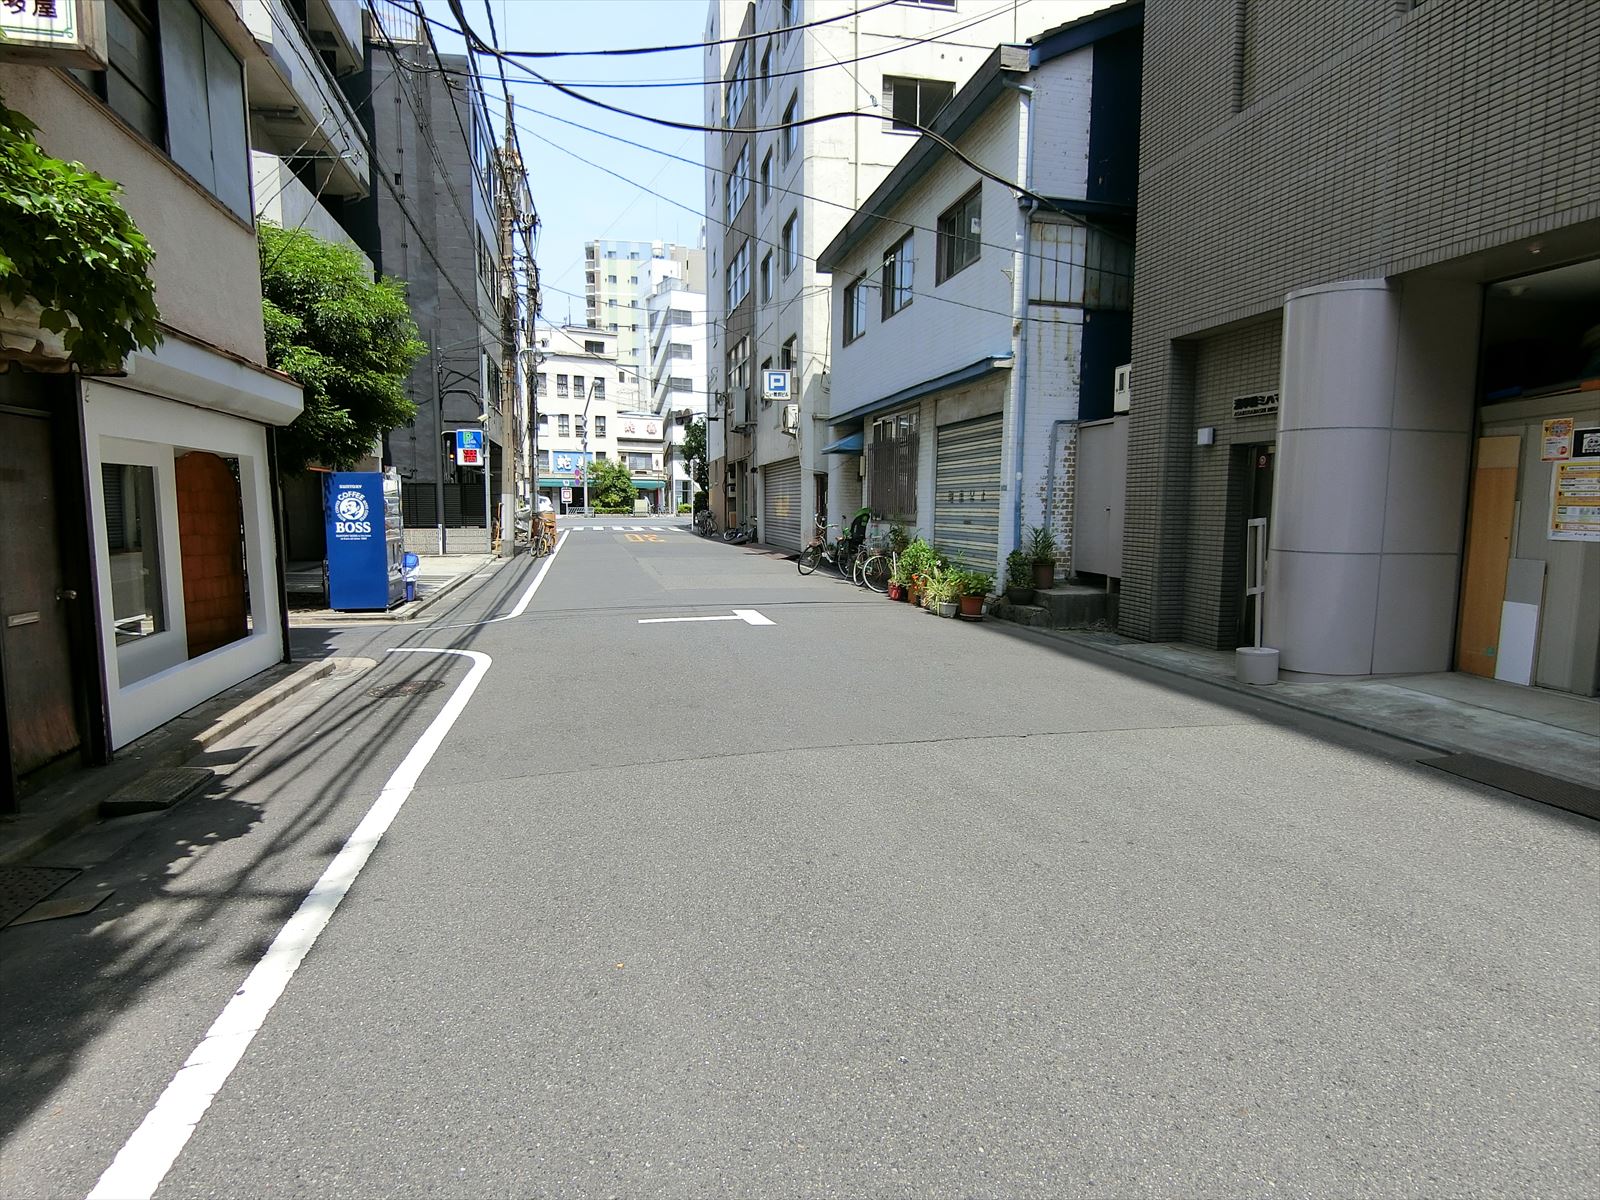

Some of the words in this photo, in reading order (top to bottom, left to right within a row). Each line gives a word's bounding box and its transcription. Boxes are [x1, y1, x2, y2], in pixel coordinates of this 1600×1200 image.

[770, 374, 785, 389] P
[337, 490, 365, 501] COFFEE
[335, 521, 371, 533] BOSS
